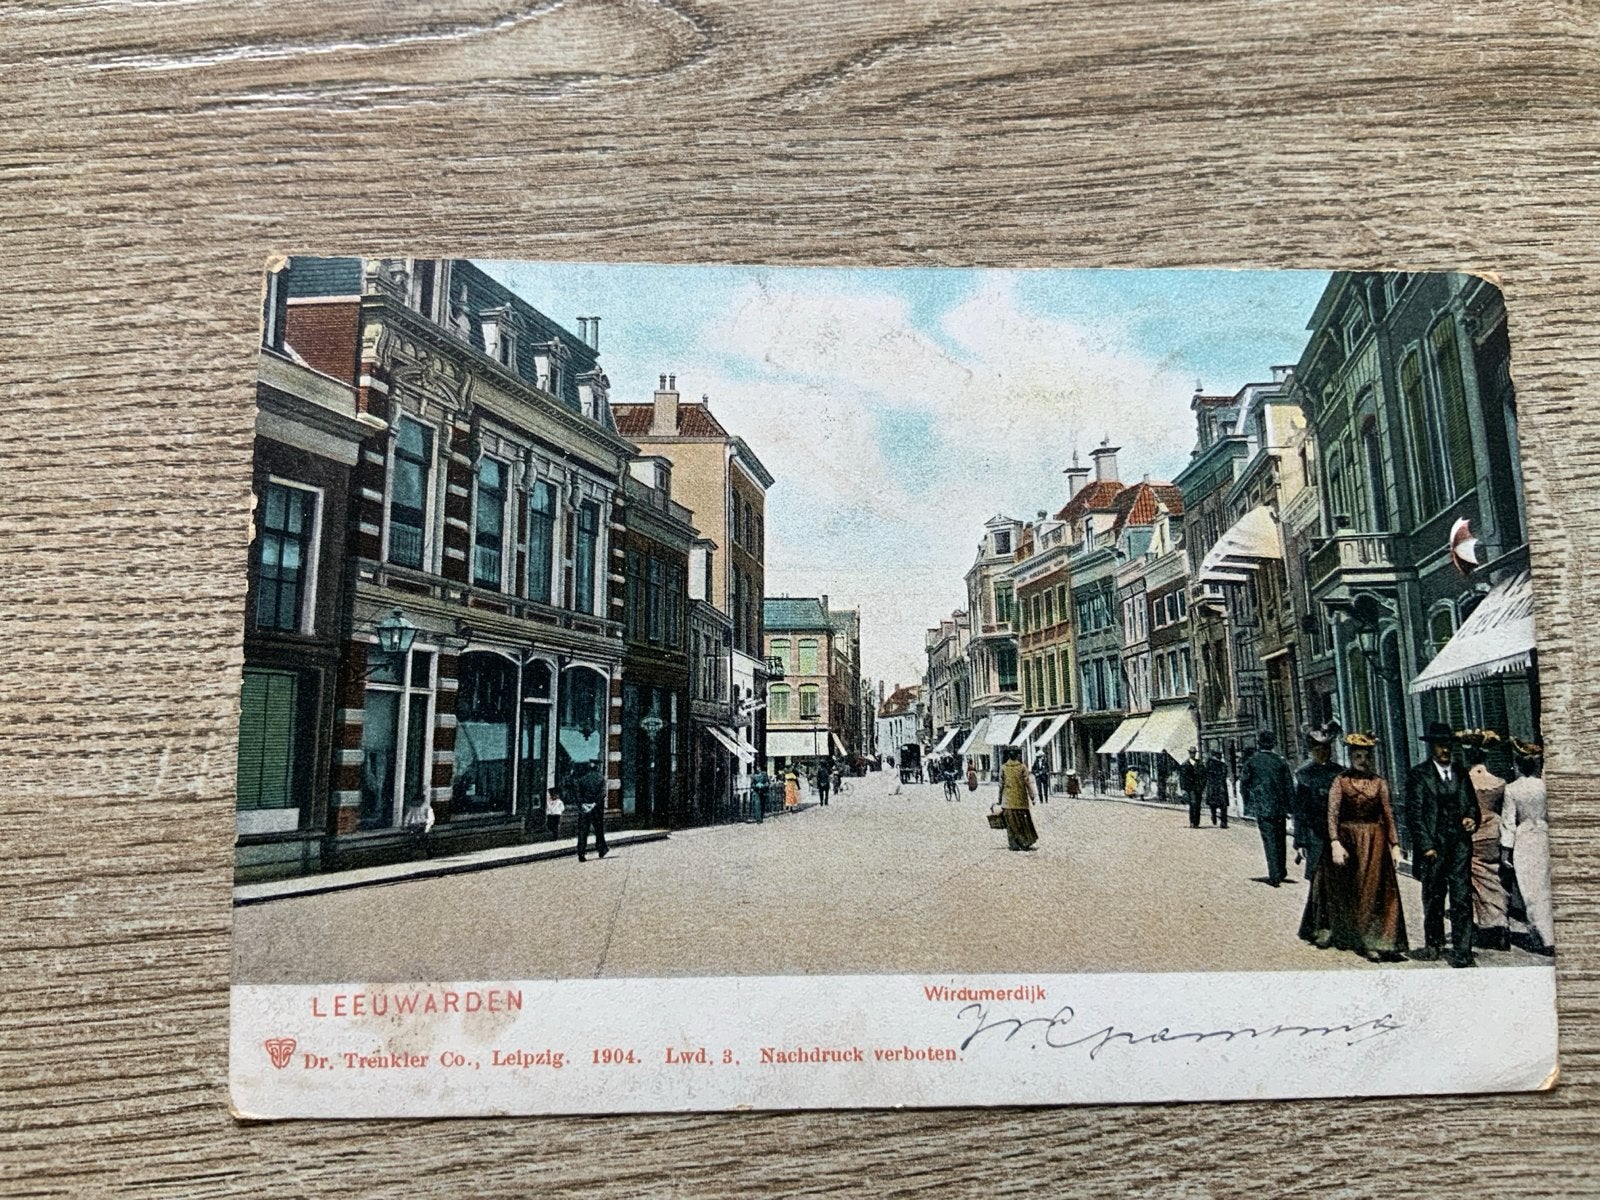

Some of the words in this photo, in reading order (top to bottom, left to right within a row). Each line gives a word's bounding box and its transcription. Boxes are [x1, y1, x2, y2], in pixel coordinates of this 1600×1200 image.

[312, 990, 523, 1018] LEEUWARDEN
[924, 985, 1047, 1003] Wirdumerdijk
[303, 1053, 334, 1070] Dr.
[343, 1051, 429, 1070] Trenkler
[440, 1051, 481, 1070] Co.,
[491, 1049, 571, 1070] Leipzig.
[592, 1048, 643, 1065] 1904.
[722, 1050, 741, 1066] 3.
[760, 1046, 864, 1064] Nachdruck
[874, 1045, 964, 1063] verboten.
